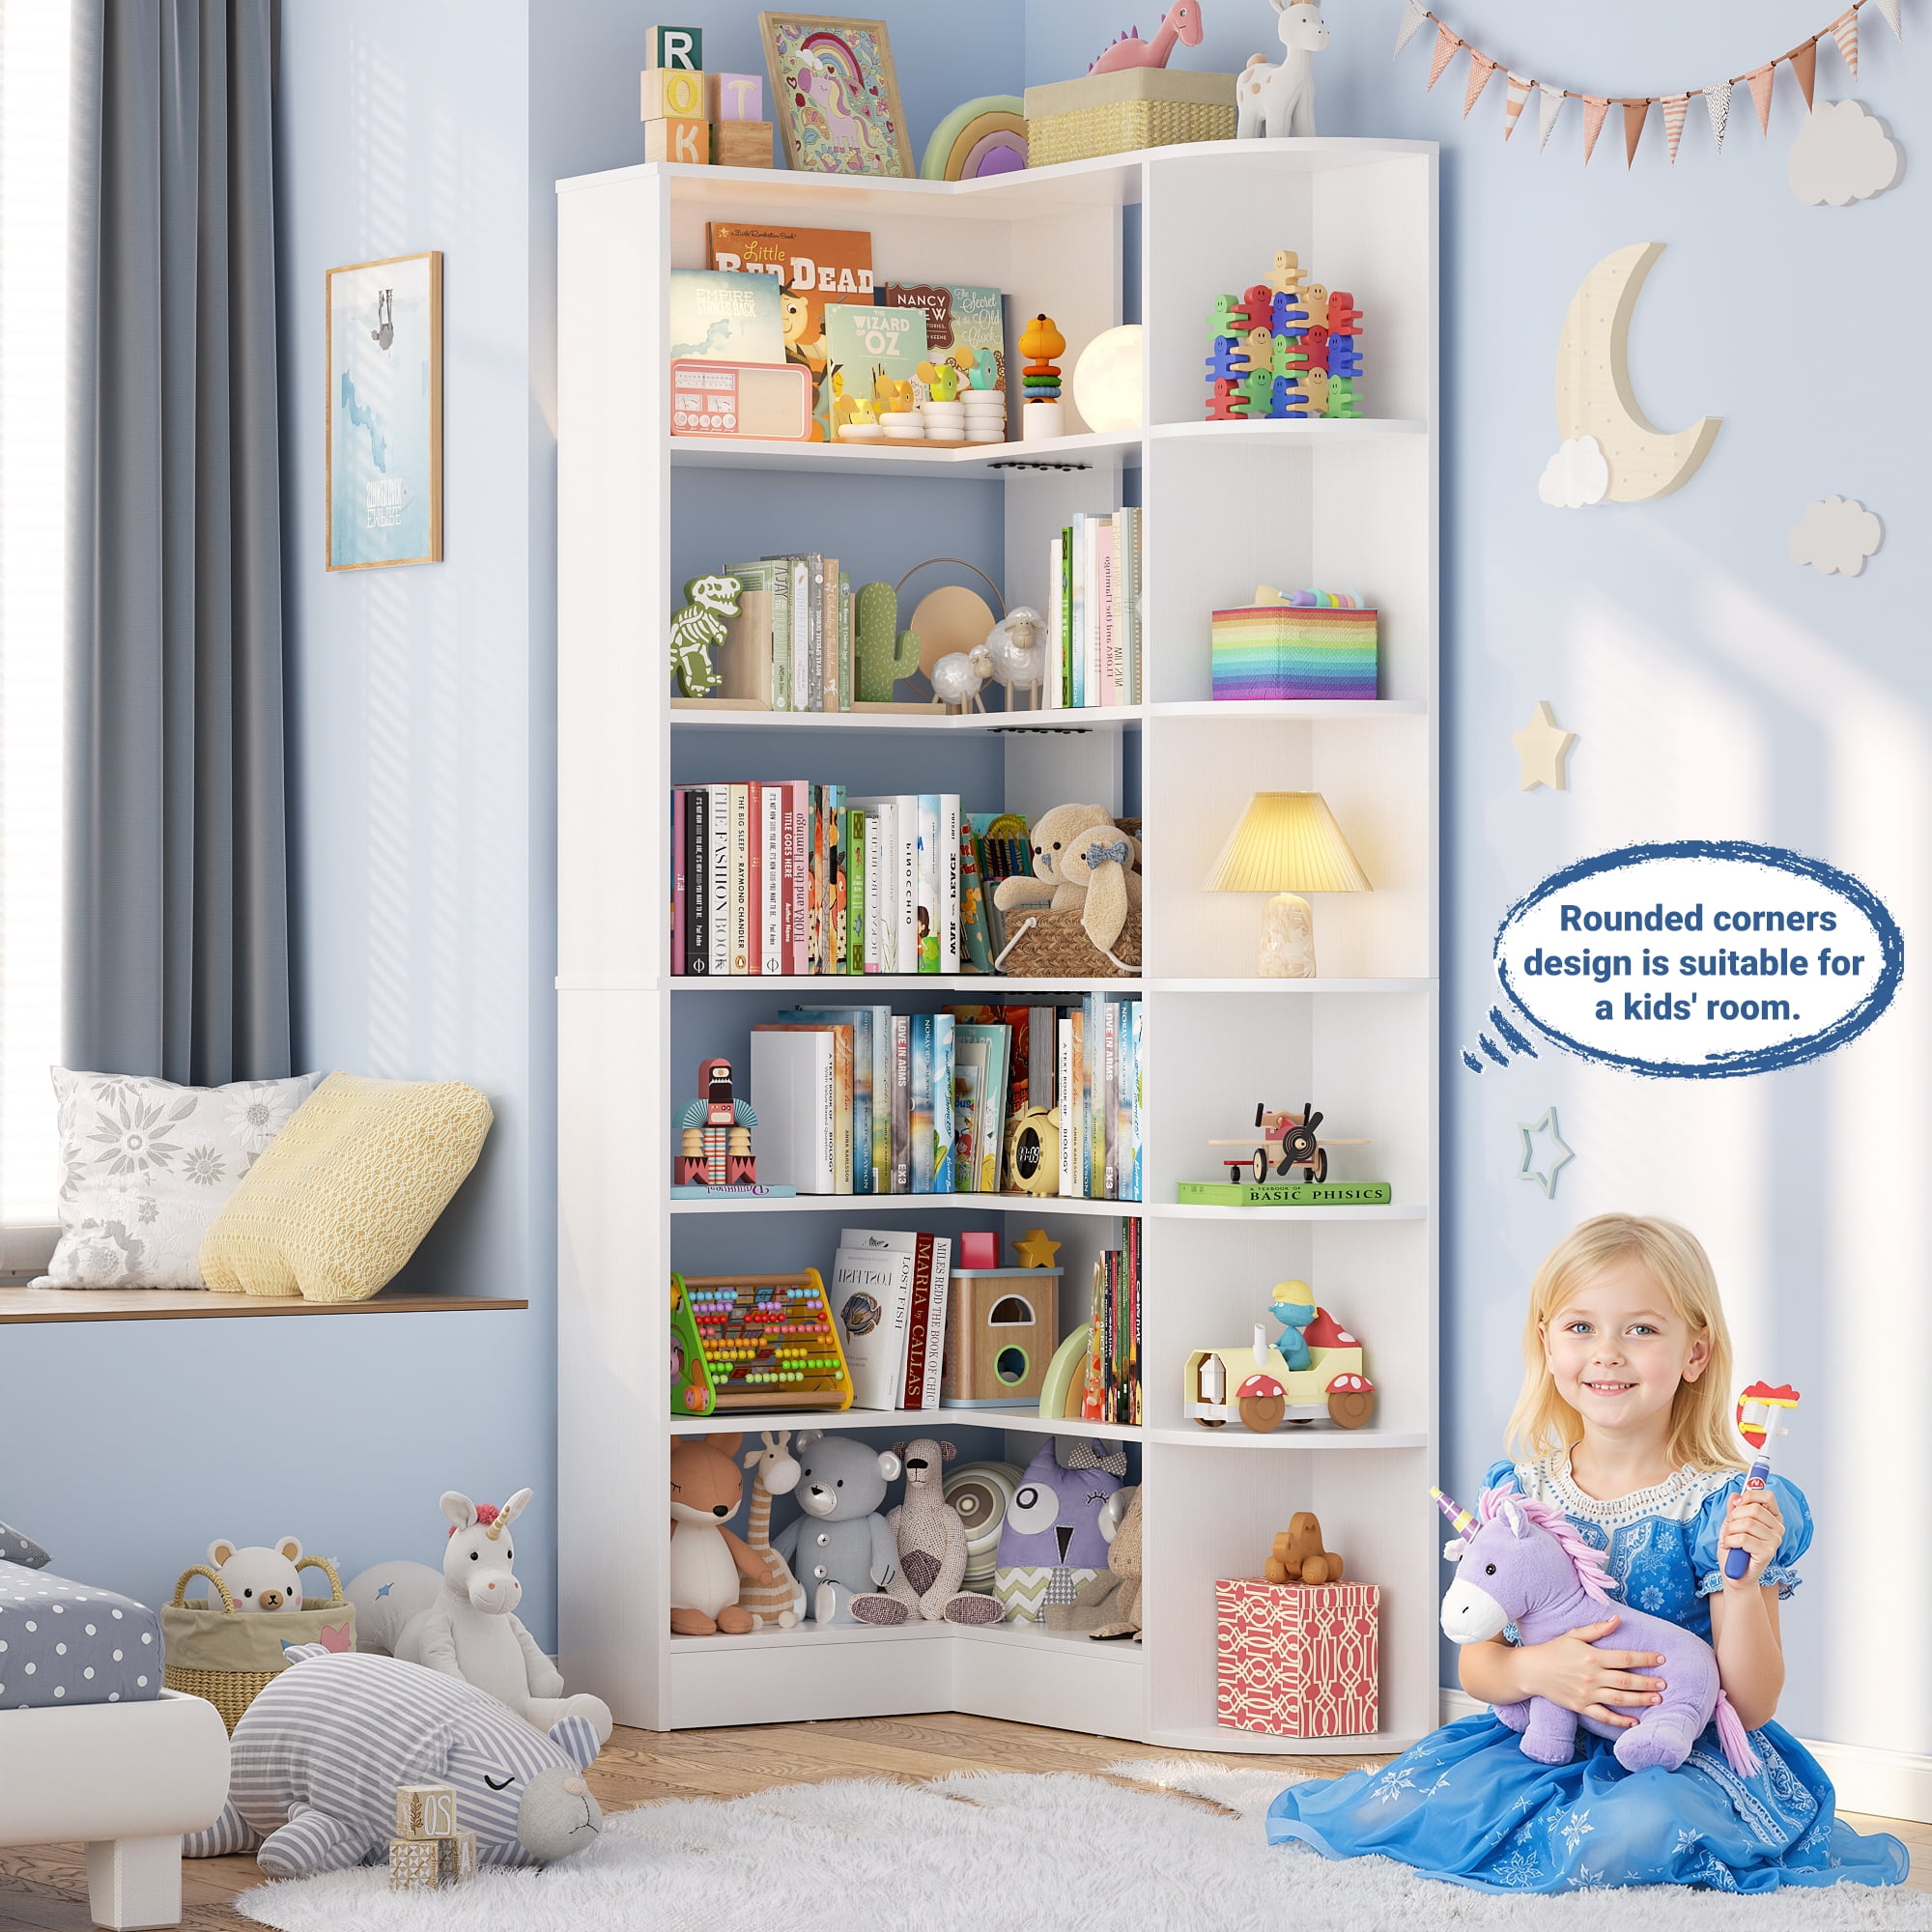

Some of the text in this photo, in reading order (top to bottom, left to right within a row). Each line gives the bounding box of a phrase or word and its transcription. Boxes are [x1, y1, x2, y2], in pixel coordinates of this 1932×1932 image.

[664, 31, 695, 70] R
[668, 74, 698, 113] O
[727, 80, 758, 120] T
[676, 124, 699, 162] K
[743, 241, 785, 262] Little
[790, 256, 874, 294] DEAD
[696, 289, 754, 302] EMPIRE
[733, 301, 756, 318] BACK
[897, 294, 946, 307] NANCY
[959, 293, 997, 313] Secret
[853, 315, 910, 332] WIZARD
[973, 309, 1001, 328] Old
[865, 330, 900, 355] OZ
[715, 787, 727, 826] THE
[715, 832, 727, 911] FASHION
[794, 812, 806, 943] FLORA and the Flamingo
[898, 1020, 907, 1087] LOVE IN ARMS
[1105, 1008, 1114, 1081] LOVE IN ARMS
[828, 1109, 834, 1121] OF
[1063, 1107, 1067, 1116] OF
[898, 1164, 907, 1184] EX3
[1105, 1167, 1114, 1189] EX3
[1250, 1189, 1383, 1201] BASIC PHISICS
[895, 1256, 911, 1329] LOST FISH
[908, 1243, 931, 1396] MARIA by CALLAS
[924, 1242, 947, 1402] MILES REDD THE BOOK OF CHIC
